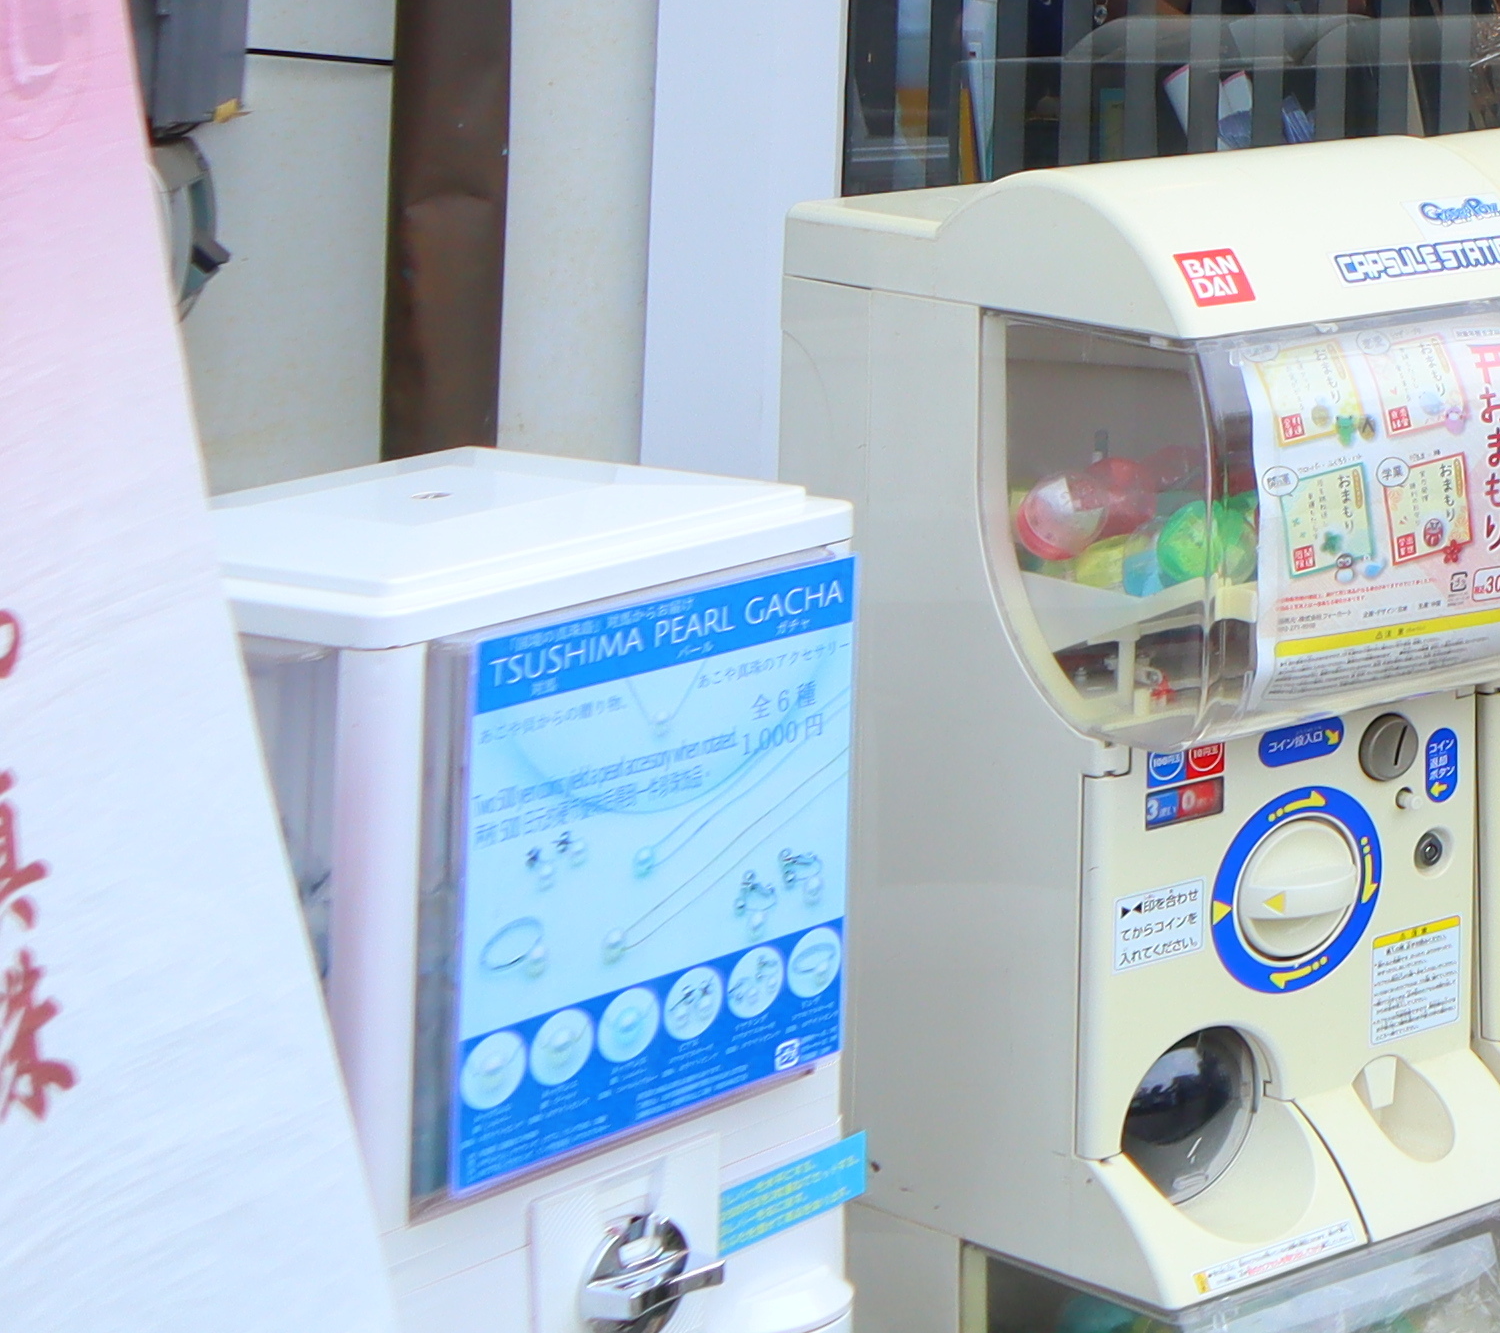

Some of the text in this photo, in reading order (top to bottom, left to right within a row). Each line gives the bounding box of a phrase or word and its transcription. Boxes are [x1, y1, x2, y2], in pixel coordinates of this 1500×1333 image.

[1181, 253, 1238, 281] BAN
[1190, 275, 1240, 300] DAI
[1381, 464, 1405, 481] 学業
[1337, 474, 1354, 532] おまもり
[1439, 464, 1456, 523] おまもり
[488, 627, 645, 687] TSUSHIMA
[653, 607, 736, 648] PEARL
[744, 580, 844, 625] GACHA
[775, 617, 812, 637] ガチャ
[1268, 730, 1324, 754] コイン投入口
[1429, 739, 1456, 754] コイン
[1429, 754, 1449, 769] 返却
[1429, 765, 1456, 780] ボタン
[1121, 912, 1198, 942] てからコインを
[1119, 937, 1198, 966] 入れてください。
